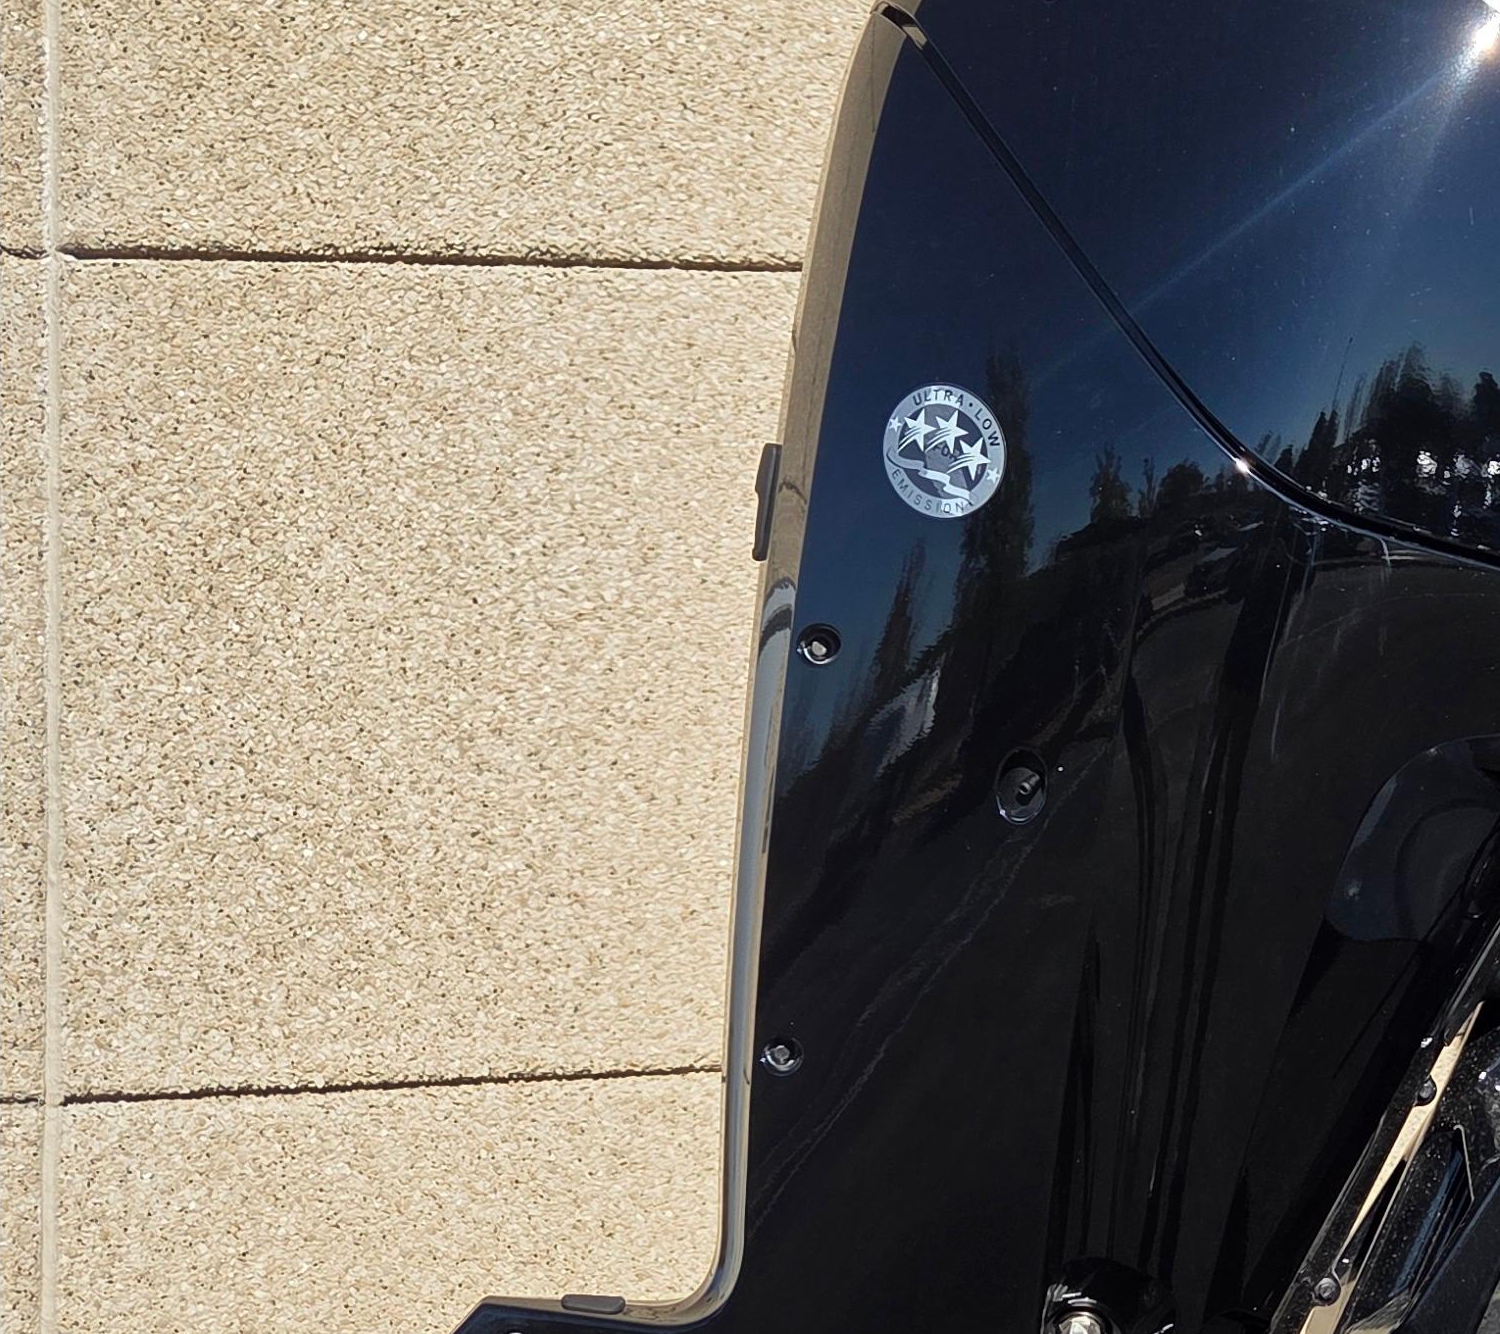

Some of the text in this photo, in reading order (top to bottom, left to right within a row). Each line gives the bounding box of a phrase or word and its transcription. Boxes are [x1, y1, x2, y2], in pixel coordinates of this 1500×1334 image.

[912, 388, 1001, 447] ULTRA LOW
[891, 468, 965, 514] EMISSION
